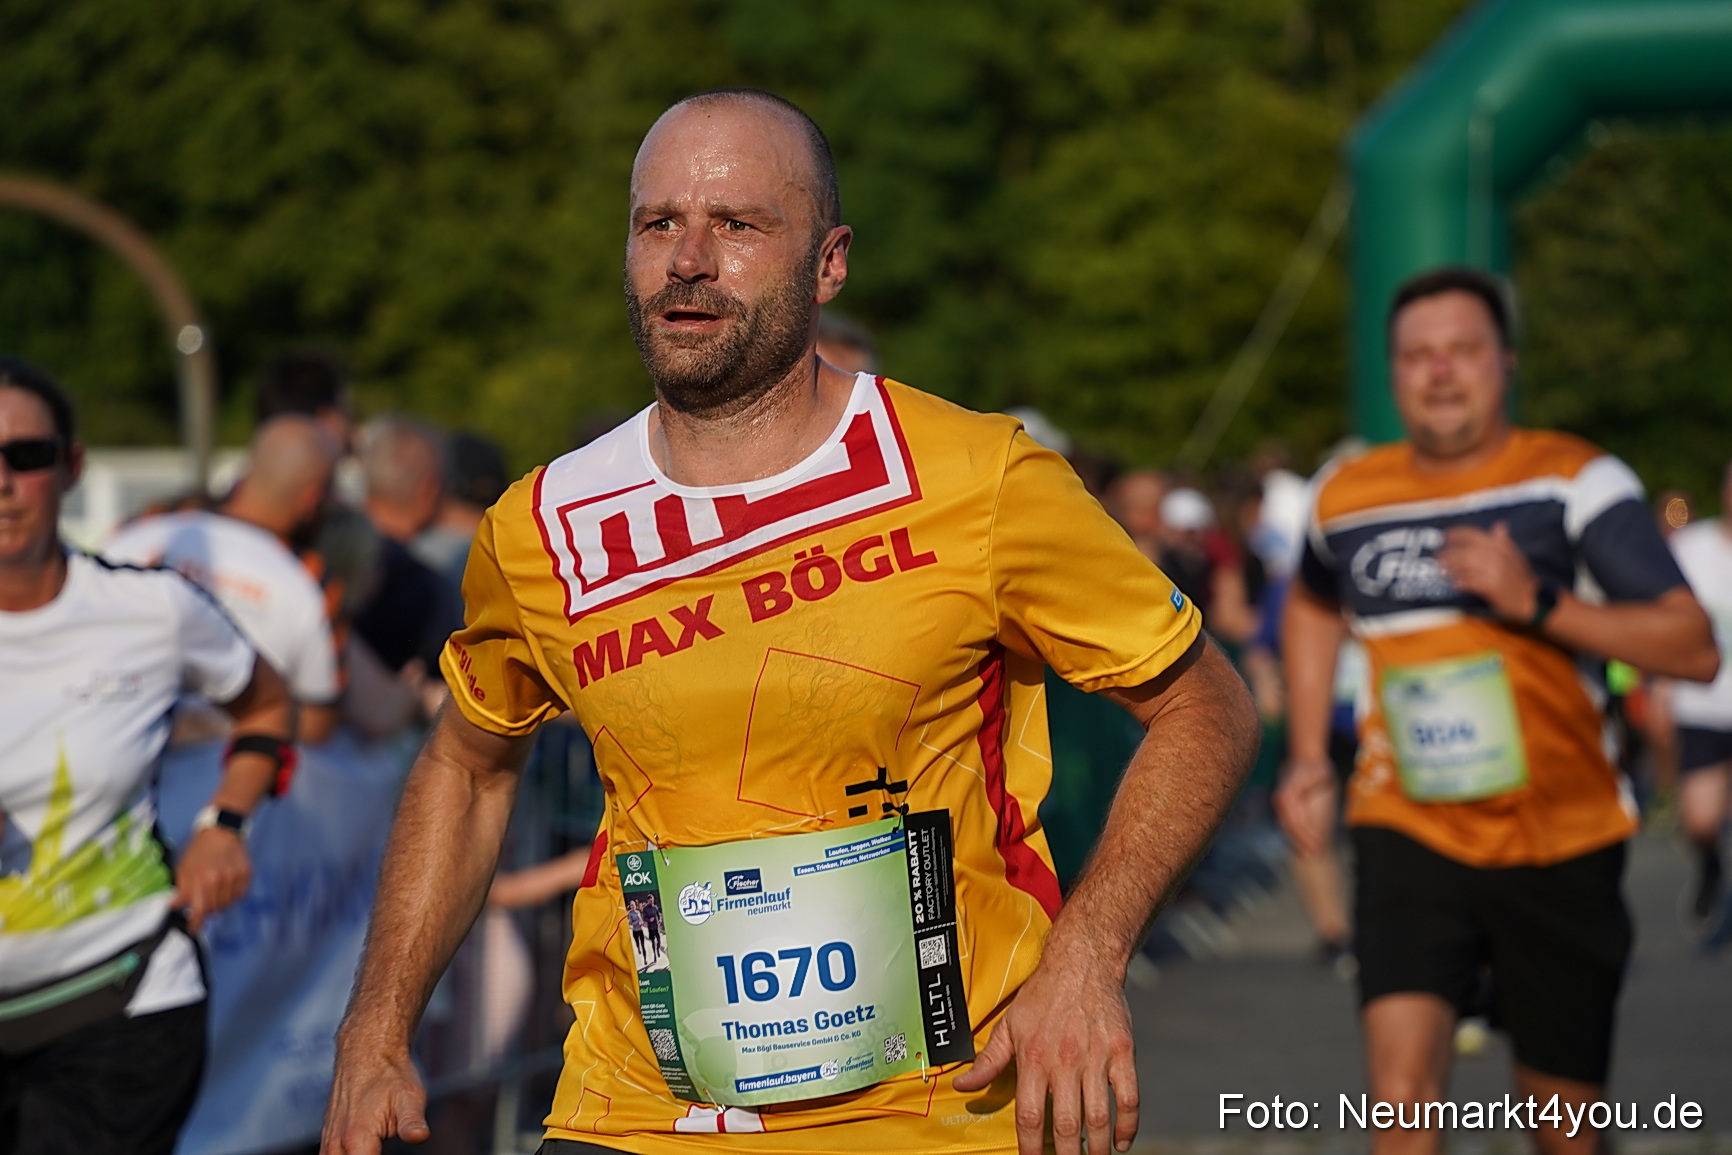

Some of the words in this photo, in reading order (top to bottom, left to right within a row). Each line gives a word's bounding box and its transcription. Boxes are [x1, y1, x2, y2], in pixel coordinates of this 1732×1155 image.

[572, 593, 726, 690] MAX
[741, 526, 938, 623] BÖGL
[871, 835, 892, 846] Walken
[921, 828, 931, 871] OUTLET
[859, 848, 891, 861] Netzwerken
[907, 829, 921, 888] RABATT
[624, 871, 652, 887] AOK
[716, 887, 791, 912] Firmenlauf
[914, 889, 922, 902] %
[924, 872, 935, 920] FACTORY
[747, 900, 792, 916] neumarkt
[914, 902, 925, 924] 20
[716, 941, 857, 1004] 1670
[650, 985, 669, 993] Laufen?
[928, 972, 950, 1047] HILTL
[721, 1018, 809, 1041] Thomas
[814, 1004, 876, 1030] Goetz
[741, 1046, 756, 1054] Max
[756, 1043, 772, 1053] Bögl
[772, 1039, 811, 1050] Bauservice
[811, 1035, 833, 1045] GmbH
[840, 1033, 851, 1041] Co.
[841, 1056, 874, 1073] Firmenlauf
[738, 1069, 817, 1091] firmenlauf.bayern
